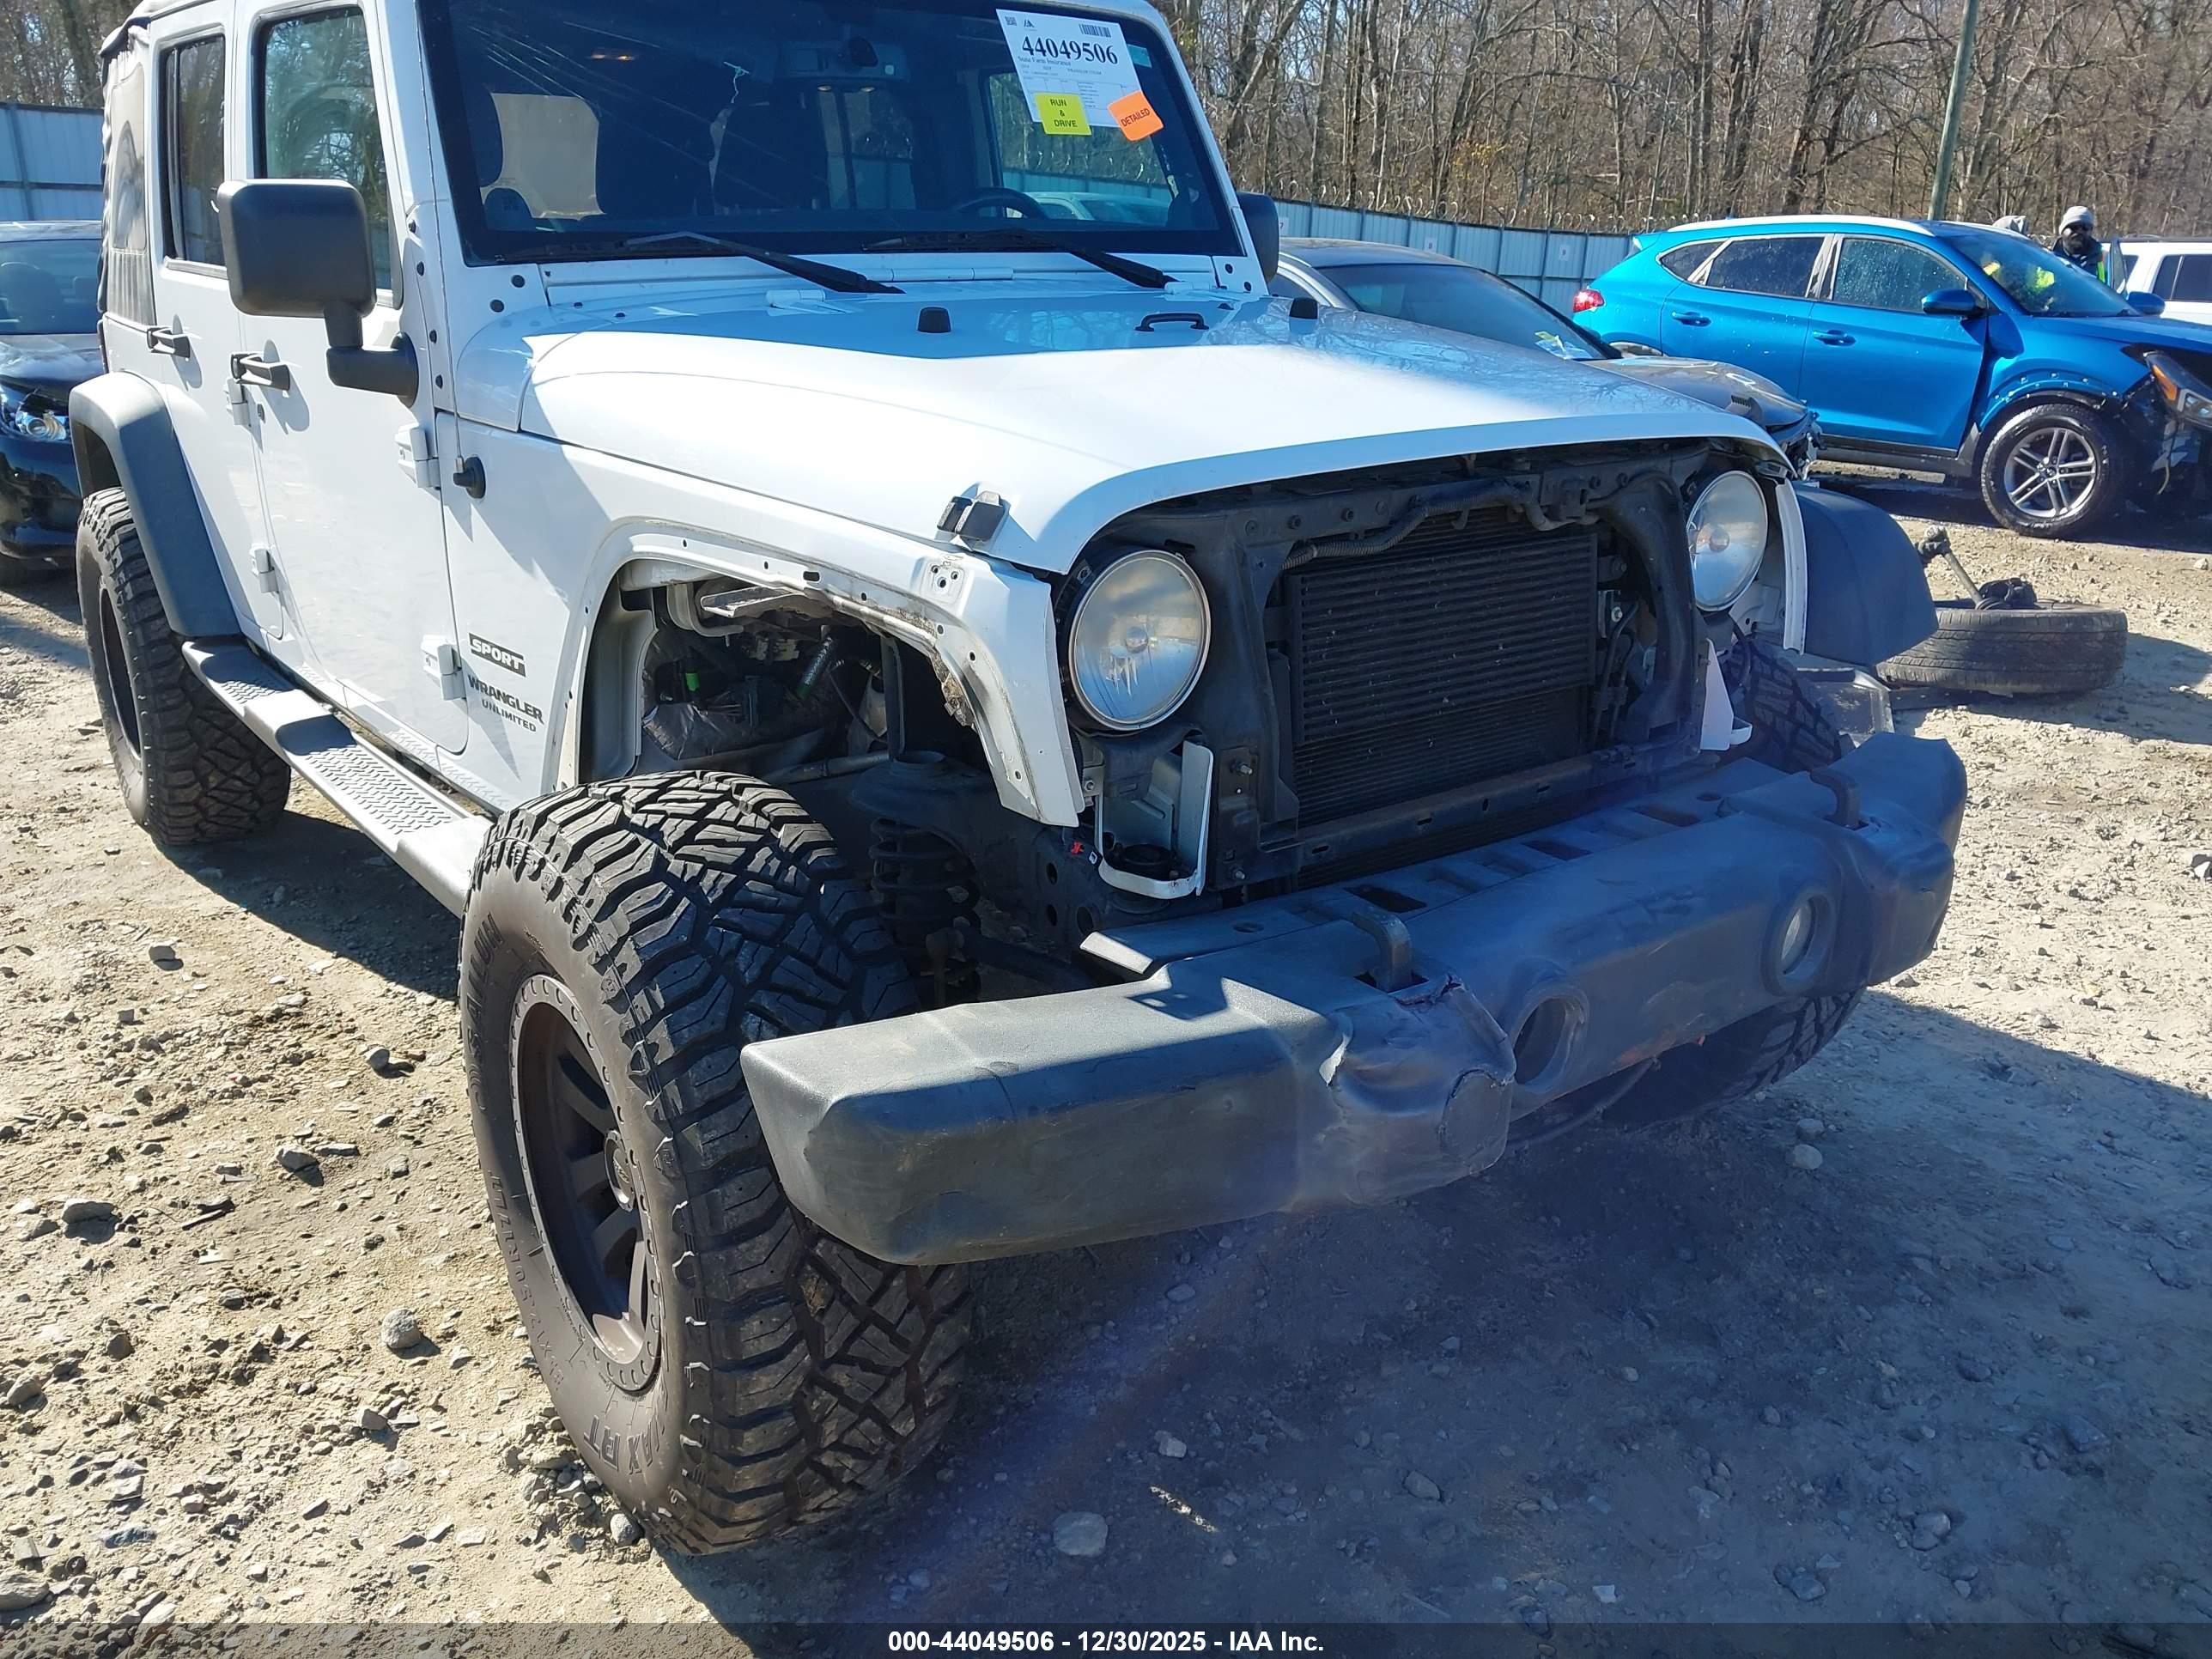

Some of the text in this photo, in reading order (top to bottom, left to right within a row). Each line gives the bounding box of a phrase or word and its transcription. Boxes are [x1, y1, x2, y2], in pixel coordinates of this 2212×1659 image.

[1022, 36, 1118, 65] 44049506
[1054, 119, 1078, 128] DRIVE
[1120, 107, 1151, 127] DETAILED
[471, 637, 526, 671] SPORT
[468, 674, 544, 726] WRANGLER
[482, 699, 536, 732] UNLIMITED
